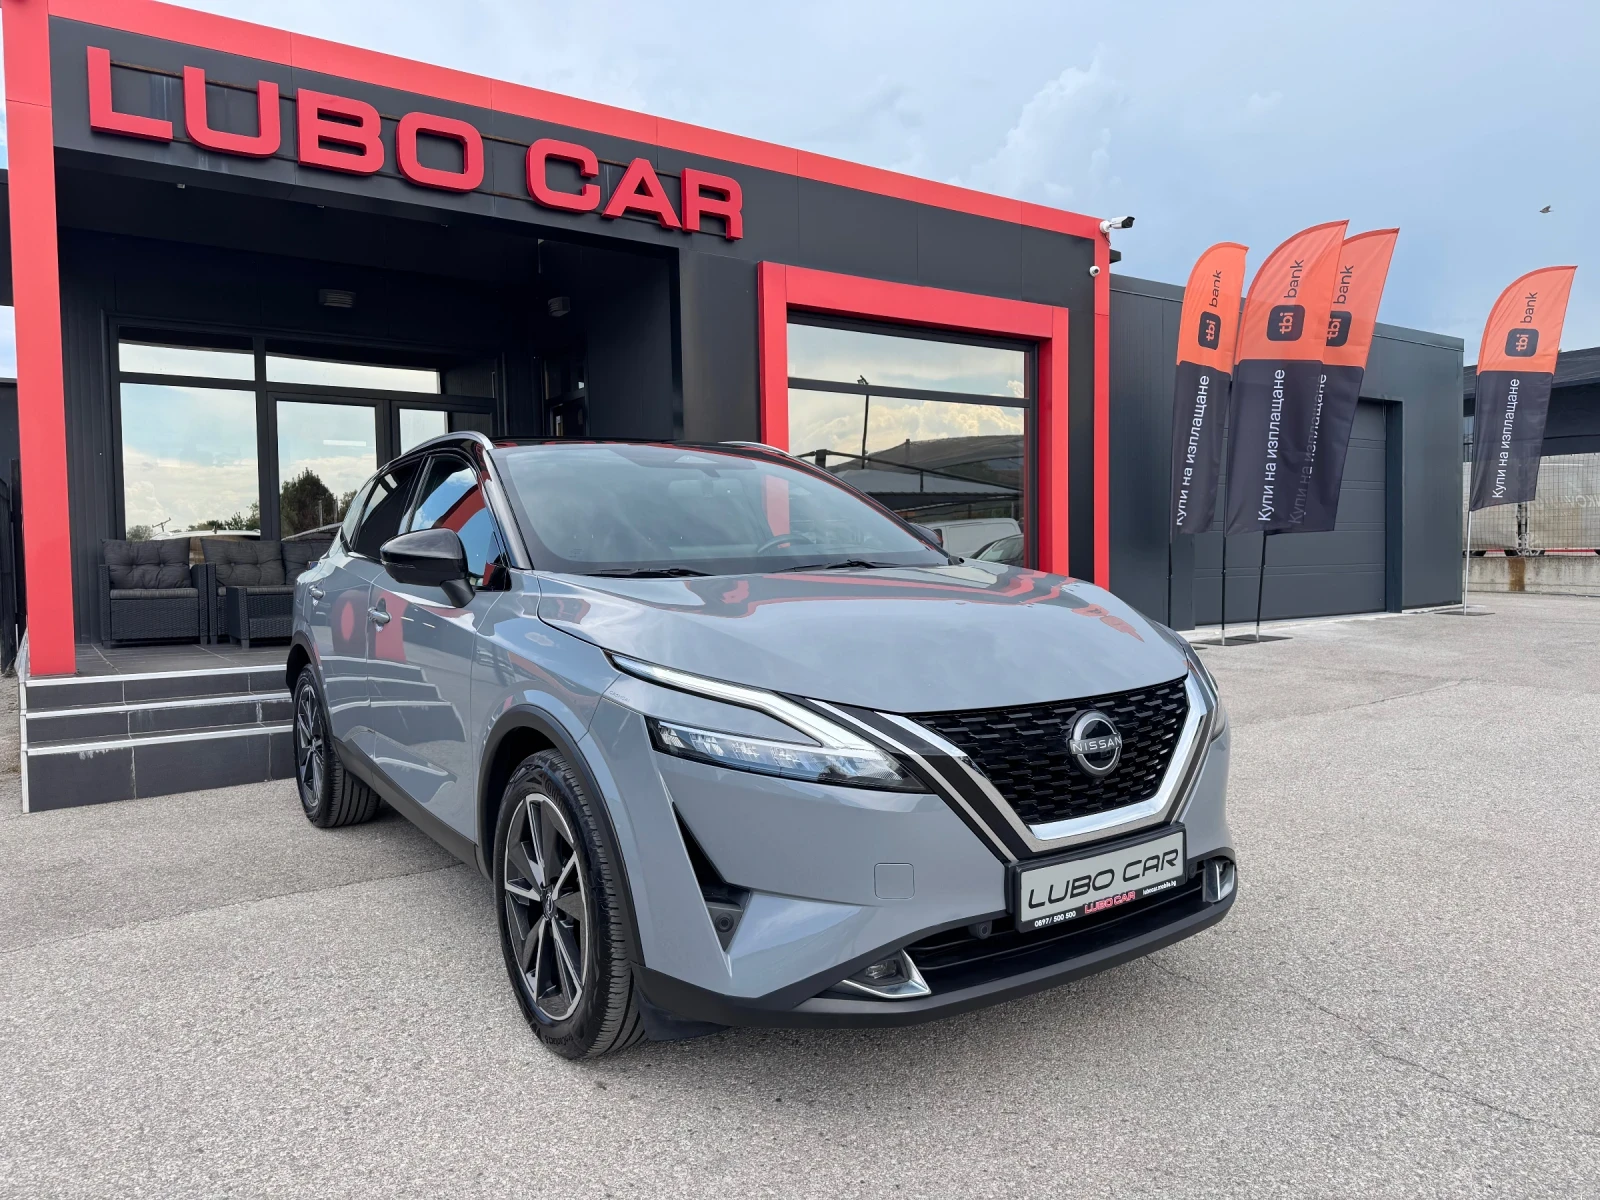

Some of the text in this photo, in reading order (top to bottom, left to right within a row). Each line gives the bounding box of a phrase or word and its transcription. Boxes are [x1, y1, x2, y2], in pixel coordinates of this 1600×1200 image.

[86, 46, 744, 241] LUBO CAR
[1205, 269, 1222, 342] tbi bank
[1278, 259, 1304, 335] tbi bank
[1332, 265, 1354, 305] bank
[1515, 291, 1538, 352] tbi bank
[1186, 375, 1210, 463] изплащане
[1257, 369, 1285, 521] Купи на изплащане
[1492, 379, 1520, 498] Купи на изплащане
[1182, 467, 1193, 486] на
[1072, 736, 1121, 753] NISSAN
[1028, 848, 1179, 909] LUBO CAR
[1084, 890, 1136, 914] LUBO CAR
[1053, 913, 1064, 922] 500
[1065, 910, 1076, 920] 500
